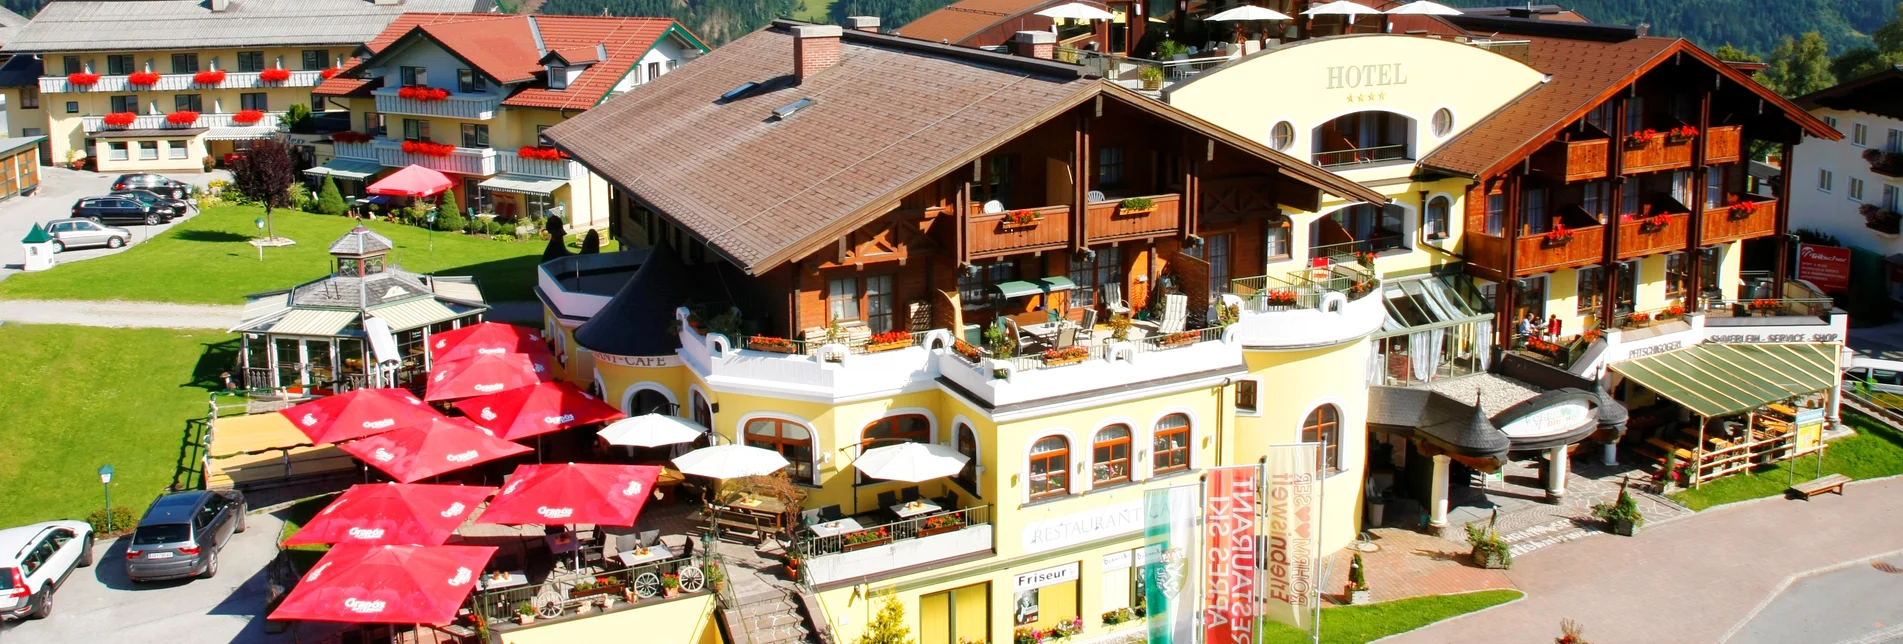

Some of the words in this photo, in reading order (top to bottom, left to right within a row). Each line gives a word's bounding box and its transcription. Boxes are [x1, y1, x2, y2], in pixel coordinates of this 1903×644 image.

[1326, 63, 1407, 89] HOTEL
[1812, 333, 1838, 343] SHOP
[1033, 507, 1142, 544] RESTAURANT
[1018, 568, 1067, 586] Friseur
